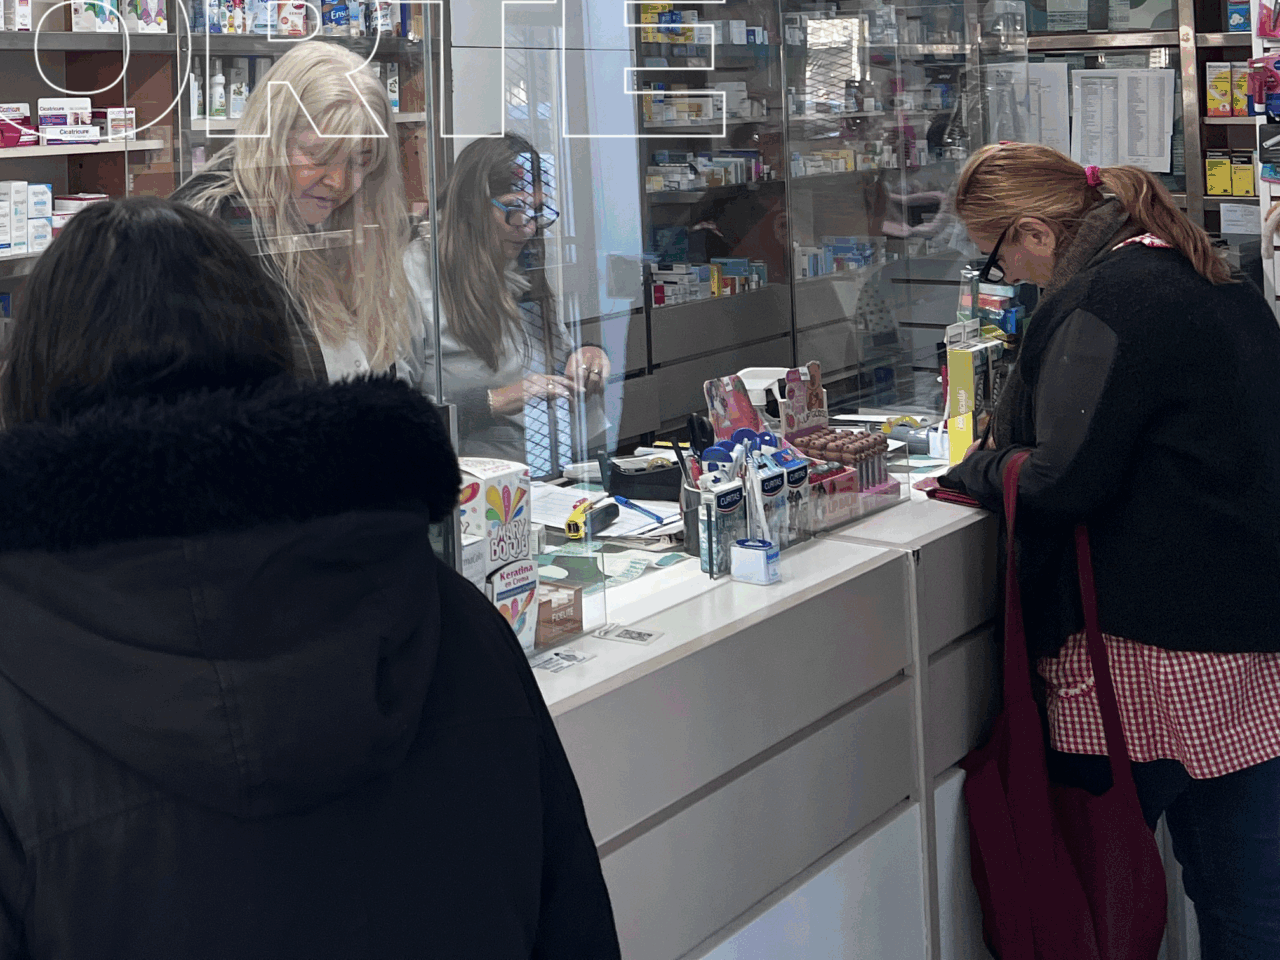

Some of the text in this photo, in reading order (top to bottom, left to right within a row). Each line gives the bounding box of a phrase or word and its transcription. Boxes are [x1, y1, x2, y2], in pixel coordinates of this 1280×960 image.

[789, 470, 806, 482] CURITAS
[764, 477, 782, 491] CURITAS
[720, 491, 740, 506] CURITAS
[497, 519, 527, 543] MARY
[500, 564, 533, 581] Keratina
